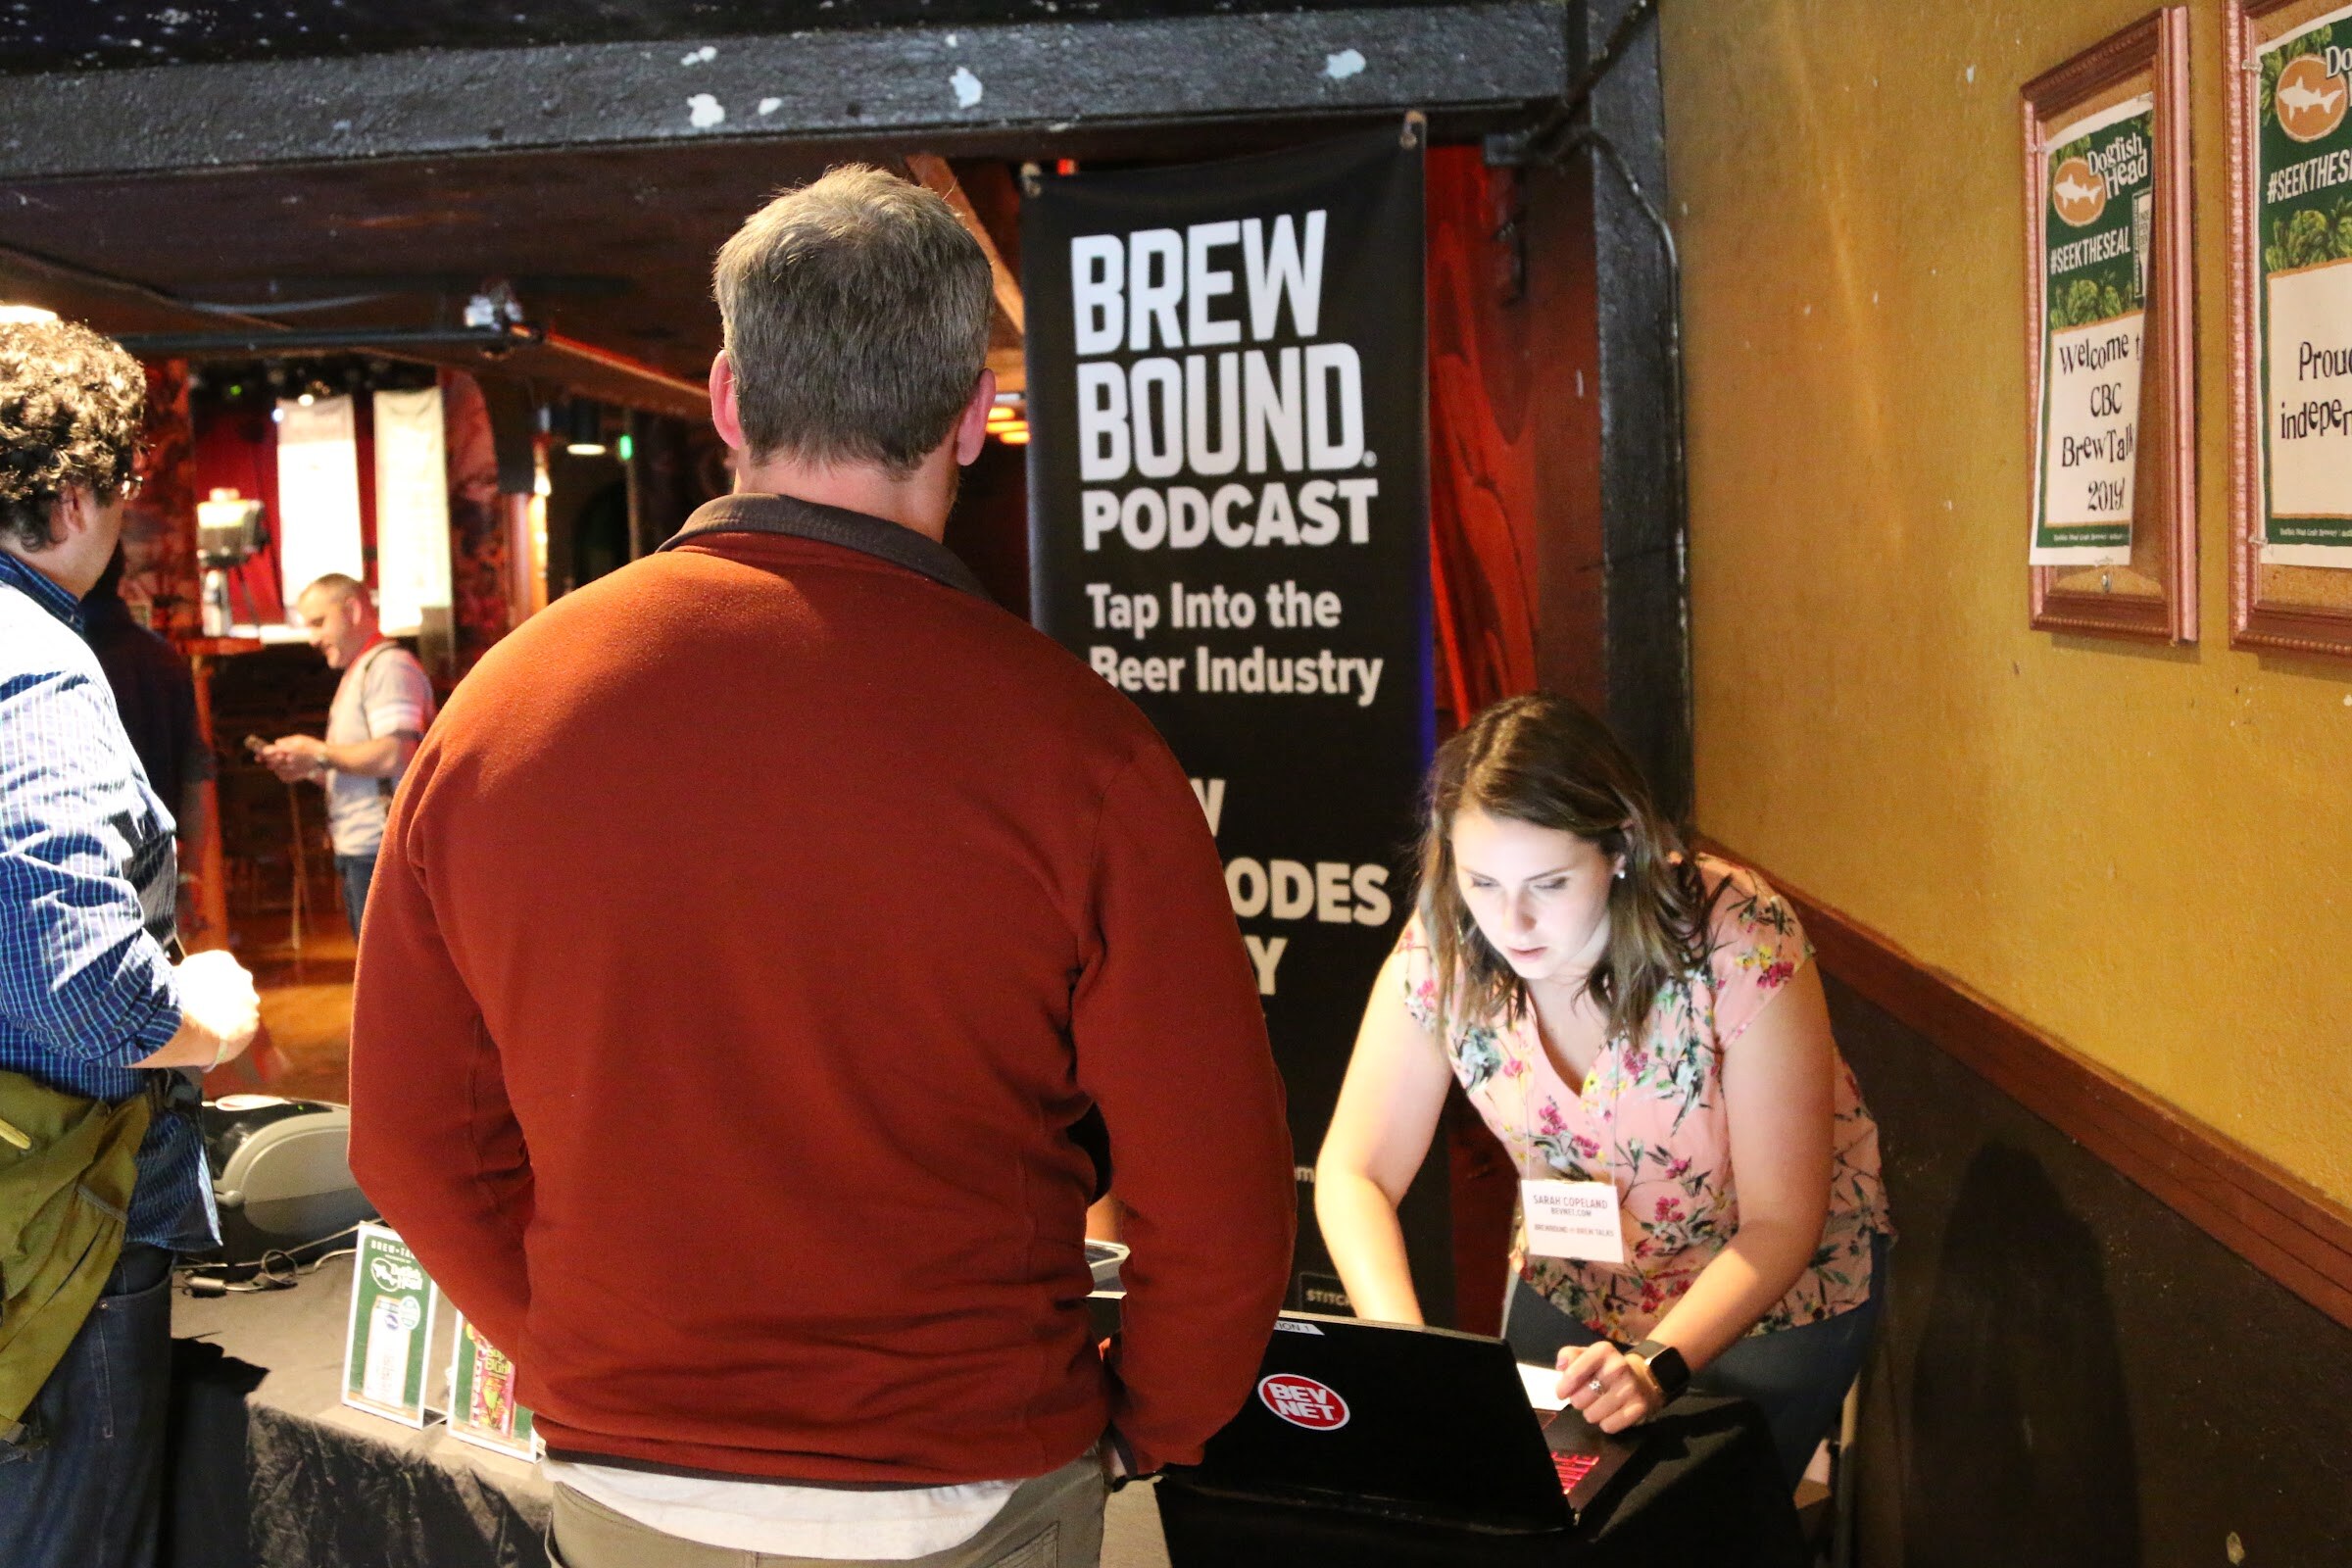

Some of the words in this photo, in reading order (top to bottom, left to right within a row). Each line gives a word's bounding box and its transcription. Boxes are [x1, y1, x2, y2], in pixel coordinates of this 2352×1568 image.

[2087, 132, 2142, 176] Dogfish
[2104, 148, 2148, 200] Head
[2050, 225, 2131, 274] #SEEKTHESEAL
[1071, 209, 1327, 356] BREW
[2059, 334, 2130, 375] Welcome
[2090, 382, 2123, 417] CBC
[1082, 478, 1379, 552] PODCAST
[1085, 583, 1160, 640] Tap
[1170, 581, 1257, 628] Into
[1266, 579, 1343, 628] the
[1090, 645, 1186, 693] Beer
[1197, 645, 1384, 708] Industry
[1533, 1194, 1561, 1205] SARAH
[1563, 1196, 1608, 1209] COPELAND
[1267, 1382, 1327, 1404] BEV
[1275, 1398, 1335, 1421] NET
